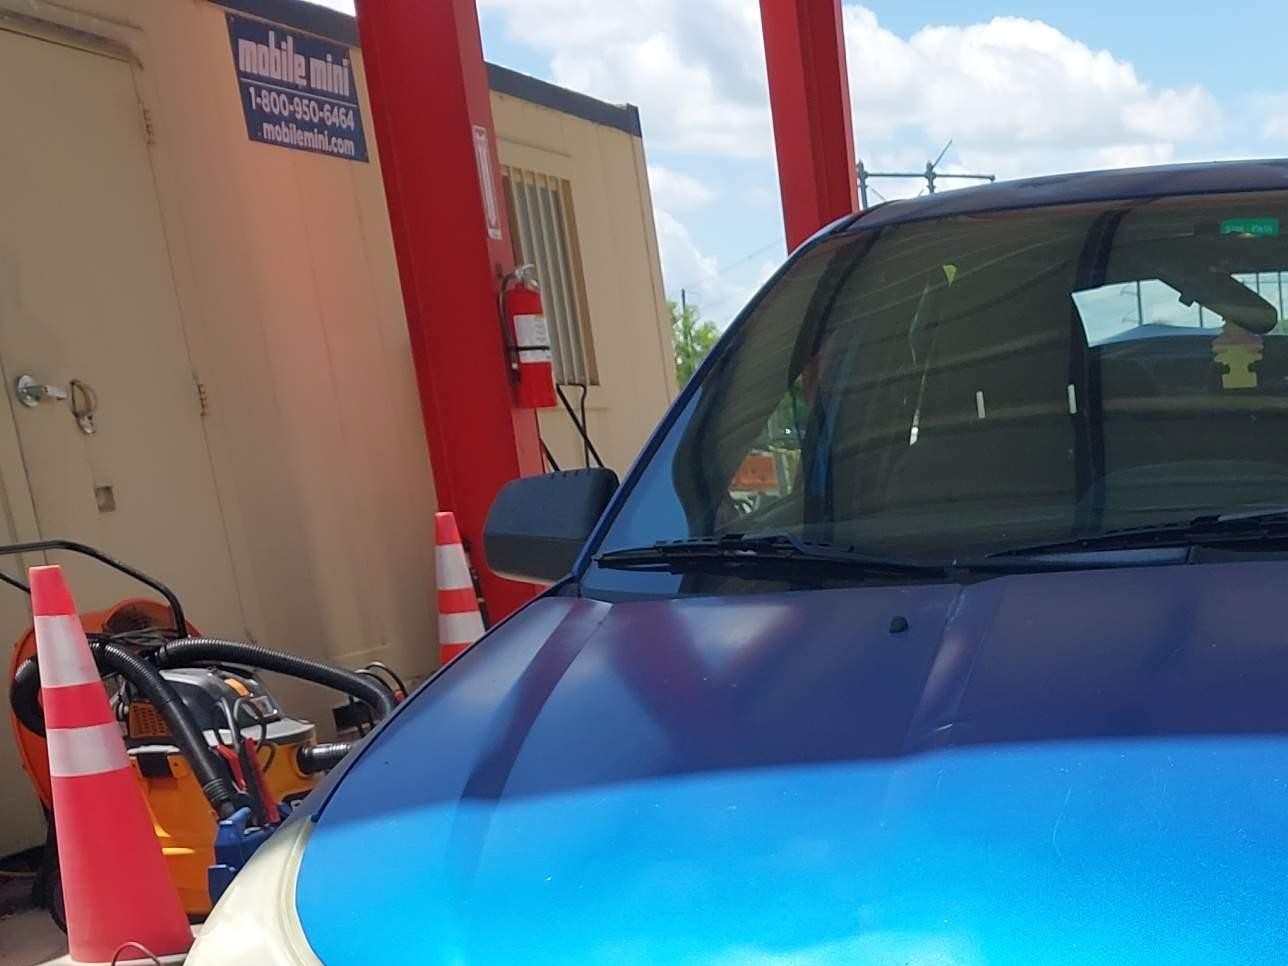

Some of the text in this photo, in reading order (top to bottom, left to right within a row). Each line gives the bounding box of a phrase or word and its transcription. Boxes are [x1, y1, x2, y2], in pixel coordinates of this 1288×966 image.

[238, 30, 350, 97] mobile mini
[249, 87, 354, 131] 1-800-950-6464
[262, 121, 355, 156] mobilemini.com
